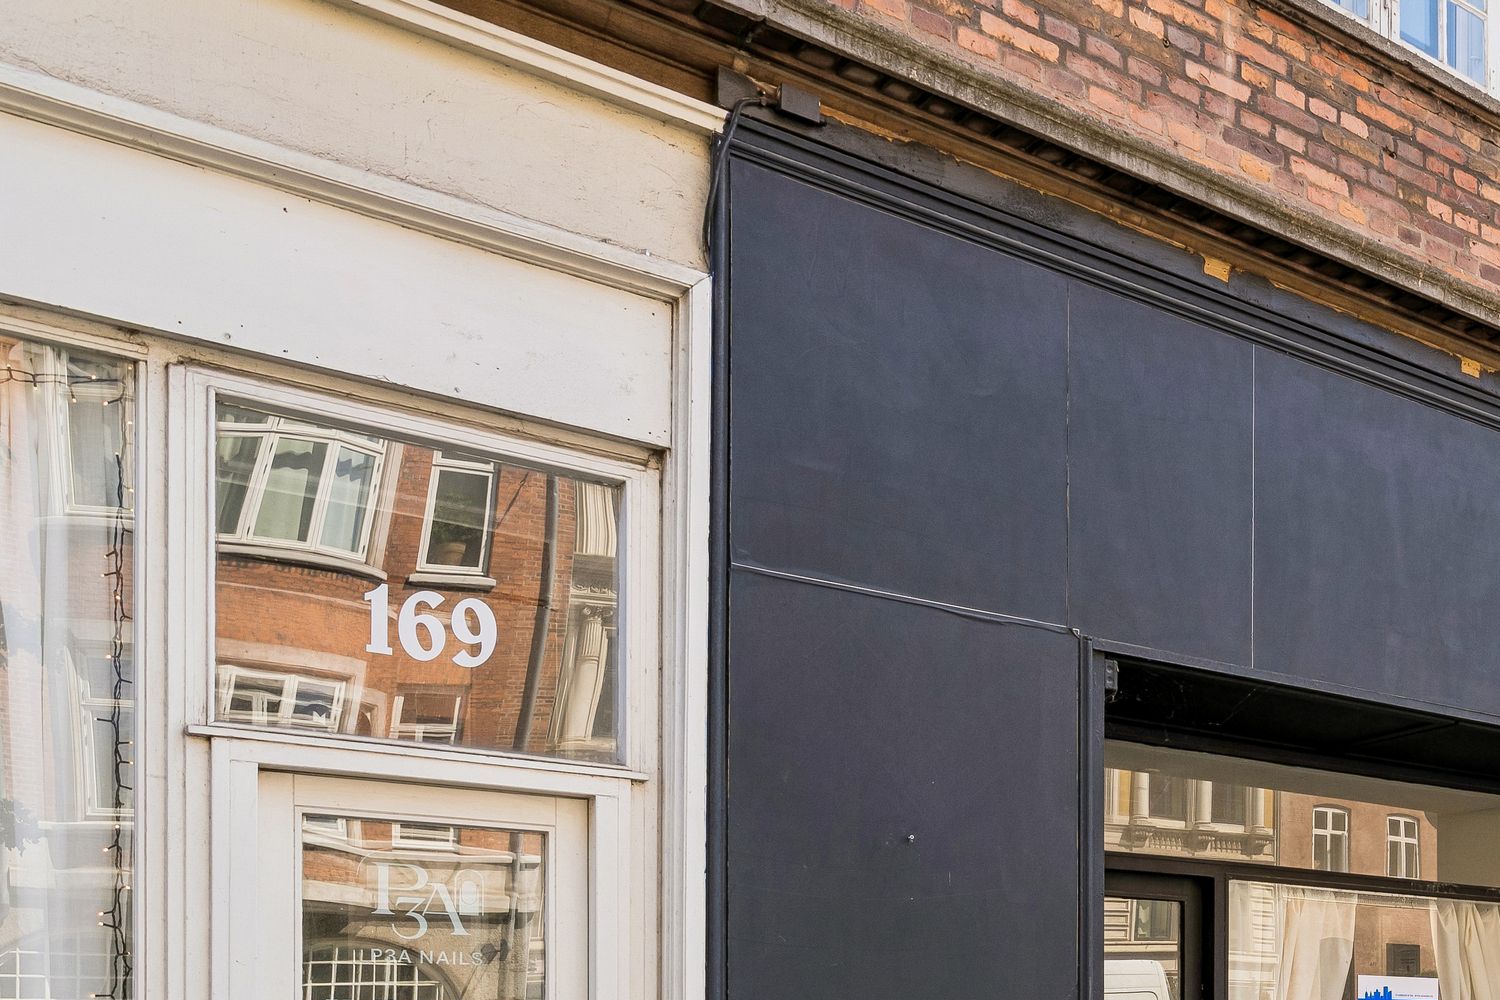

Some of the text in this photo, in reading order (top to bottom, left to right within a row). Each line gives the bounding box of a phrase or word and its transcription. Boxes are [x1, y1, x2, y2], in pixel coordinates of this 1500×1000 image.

[364, 583, 498, 668] 169
[371, 948, 483, 967] P3A NAILS
